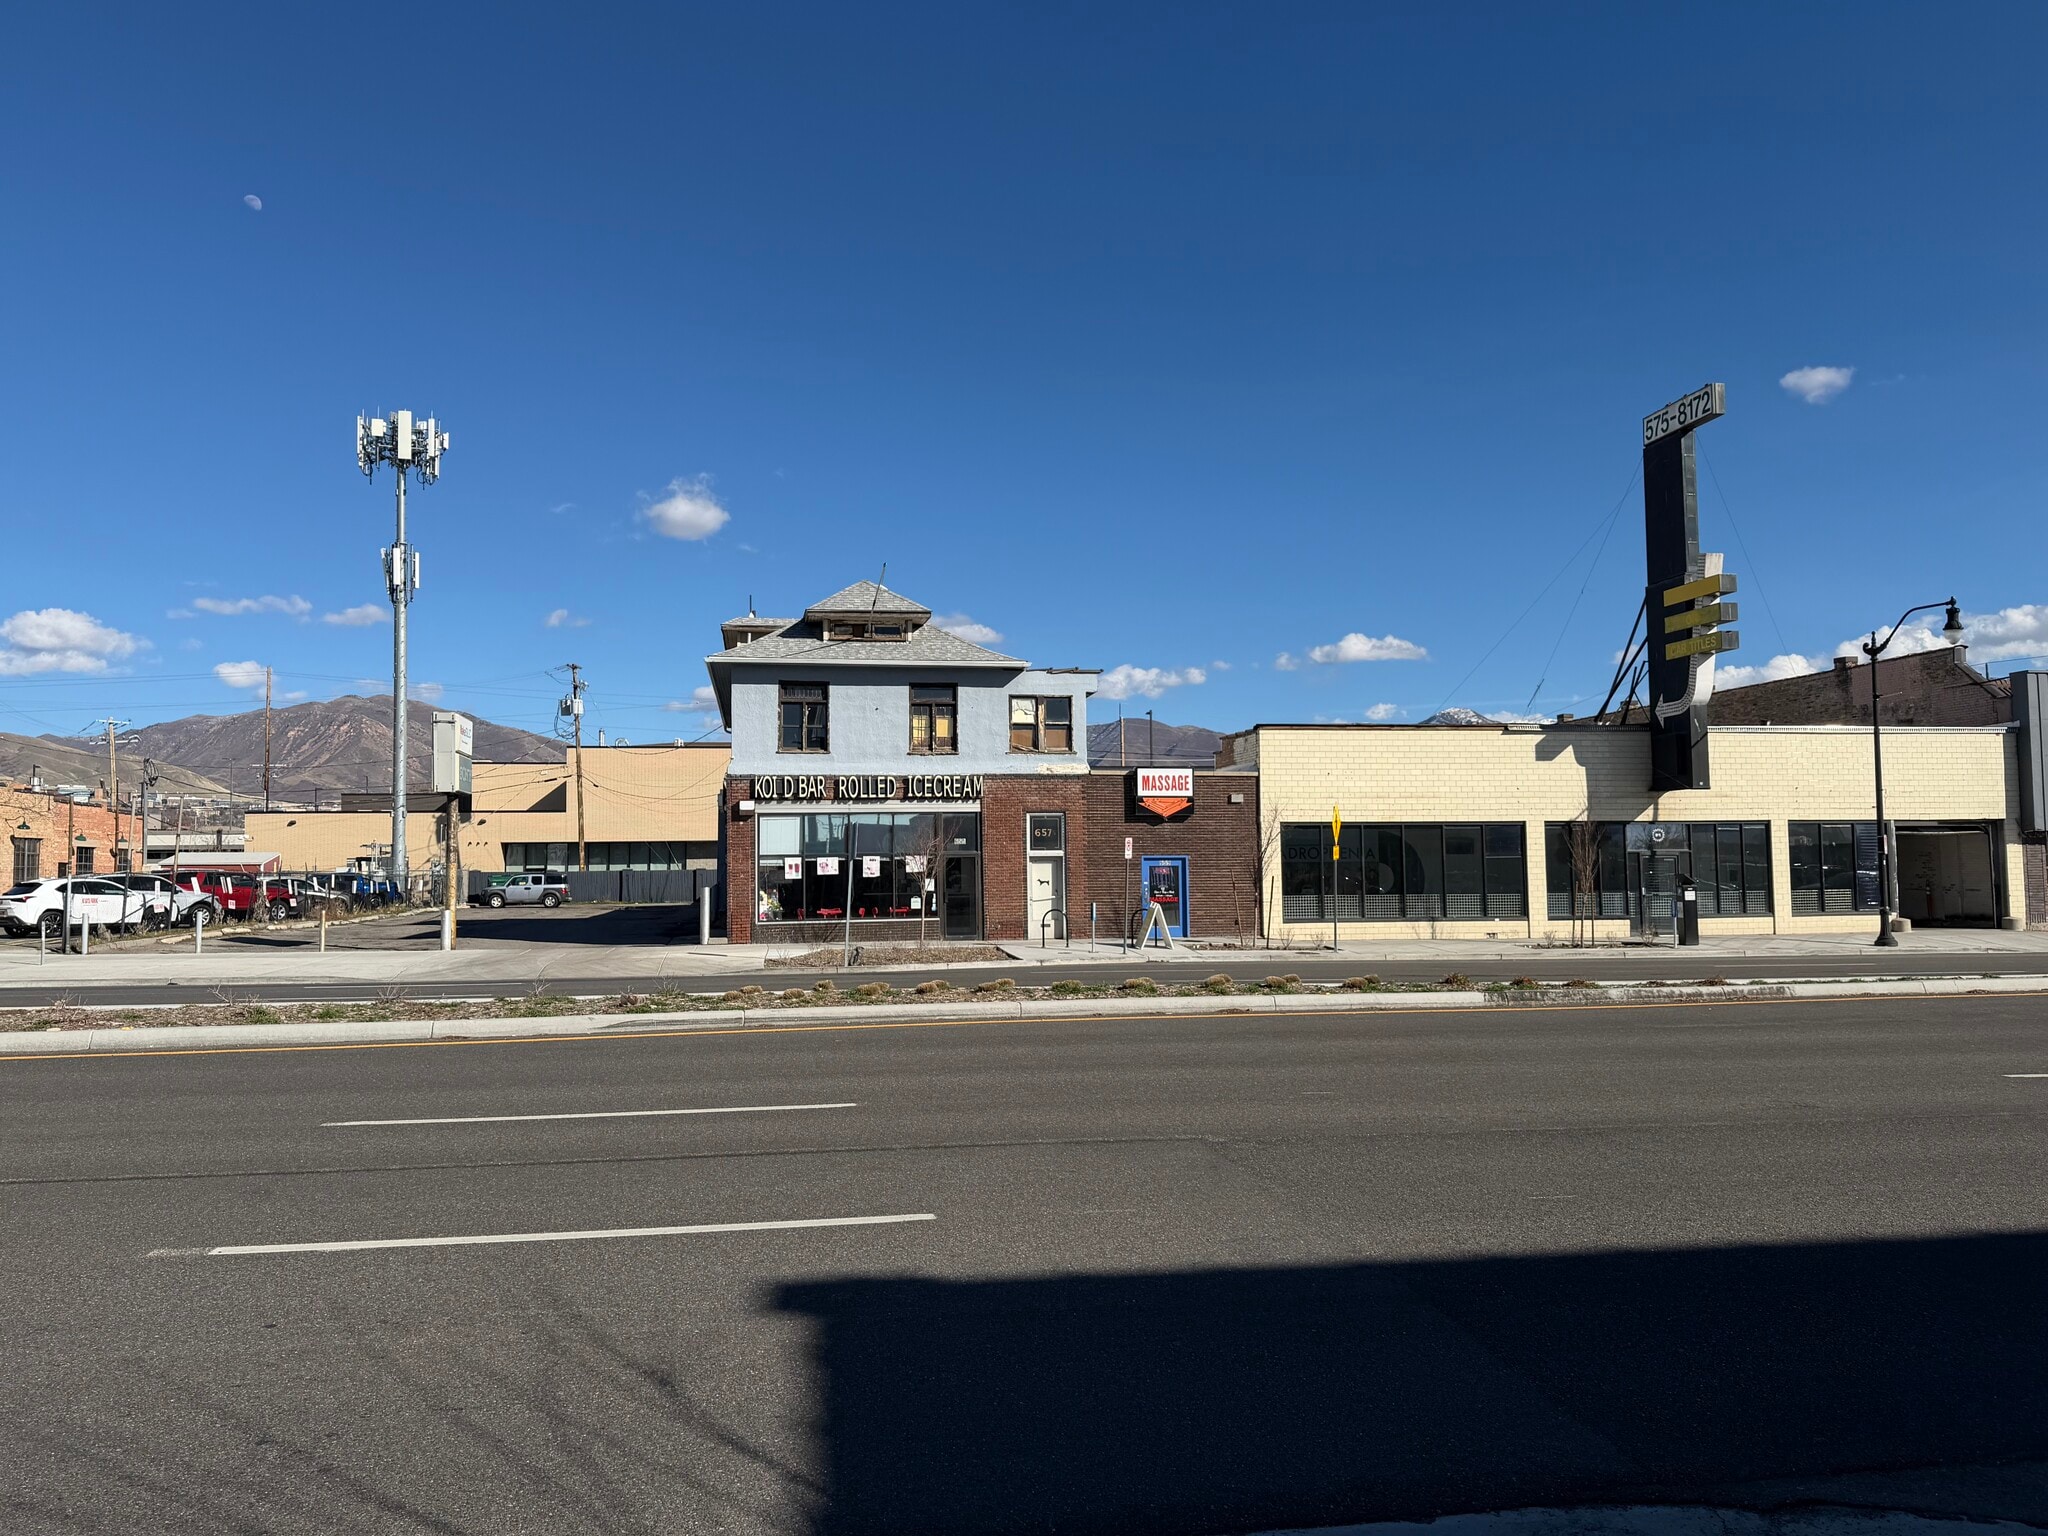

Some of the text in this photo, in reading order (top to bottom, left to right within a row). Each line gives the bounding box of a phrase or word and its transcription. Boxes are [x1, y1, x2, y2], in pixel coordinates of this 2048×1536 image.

[1645, 390, 1711, 441] 575-8172
[1670, 635, 1716, 655] CAR TITLES
[799, 775, 827, 798] BAR
[839, 775, 897, 798] ROLLED
[907, 775, 984, 797] ICECREAM
[1141, 774, 1190, 791] MASSAGE
[1034, 828, 1052, 837] 657
[1282, 846, 1376, 860] DROPENA
